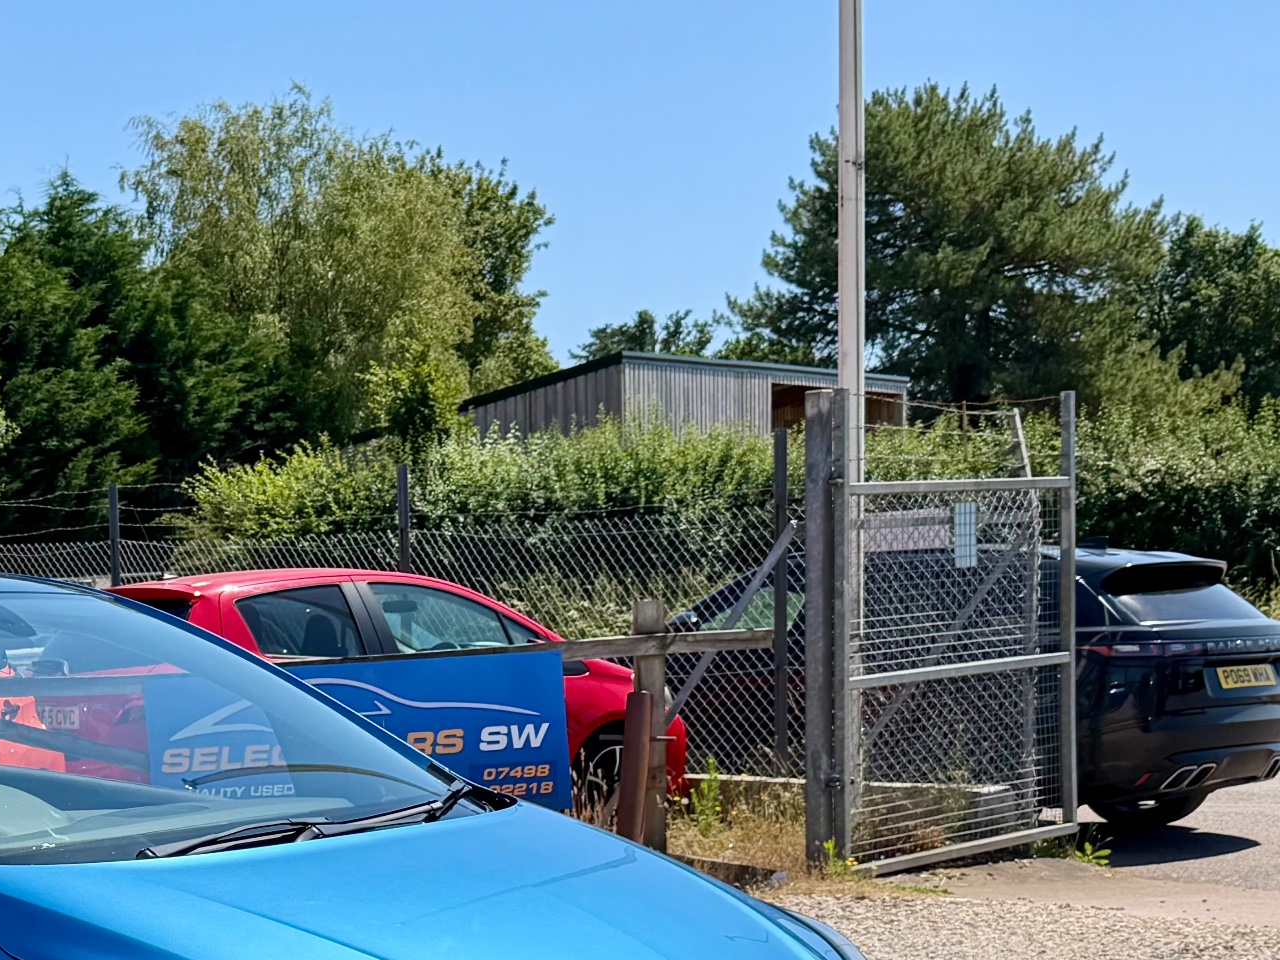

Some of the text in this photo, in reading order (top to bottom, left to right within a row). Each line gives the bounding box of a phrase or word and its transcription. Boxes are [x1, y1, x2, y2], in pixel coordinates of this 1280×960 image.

[56, 709, 76, 725] CVC
[479, 722, 550, 751] SW
[483, 764, 550, 781] 07498
[250, 784, 296, 796] USED
